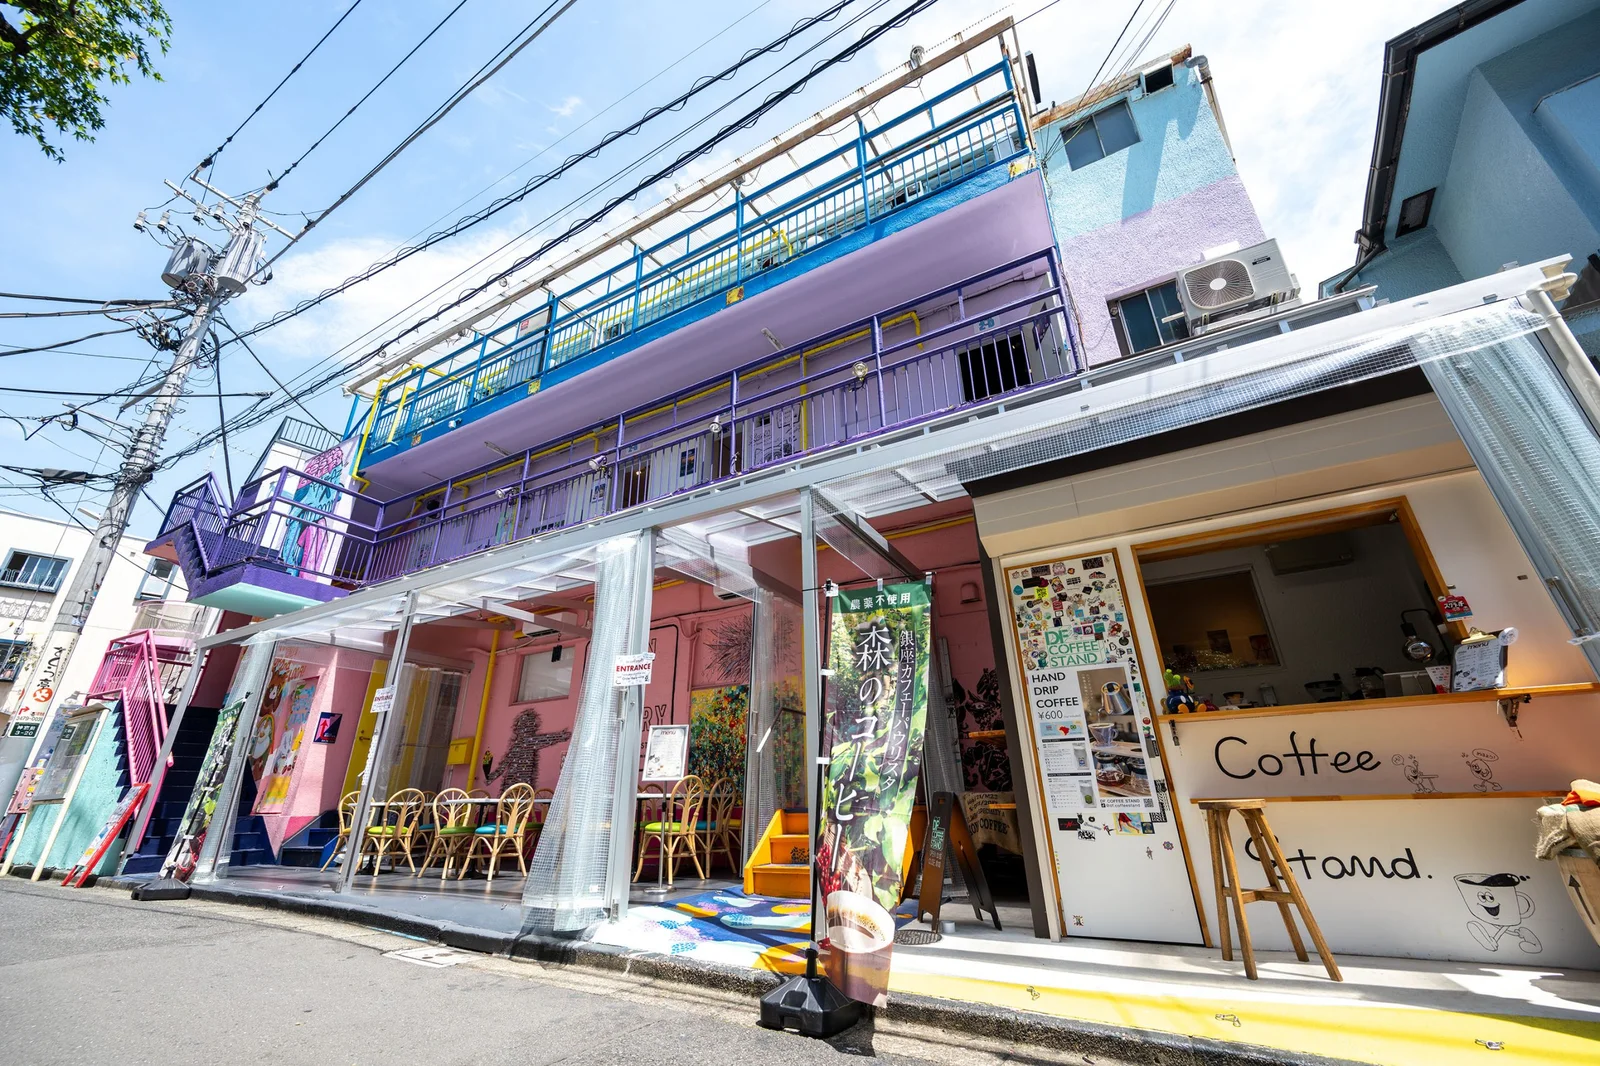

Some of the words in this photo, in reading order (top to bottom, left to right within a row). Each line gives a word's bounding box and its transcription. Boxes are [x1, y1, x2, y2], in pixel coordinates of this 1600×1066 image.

[850, 592, 911, 610] 農薬不使用
[1044, 628, 1069, 645] DF
[1048, 640, 1099, 656] COFFEE
[1467, 642, 1489, 650] menu
[1050, 653, 1098, 667] STAND
[616, 663, 651, 672] ENTRANCE
[1031, 672, 1066, 684] HAND
[1033, 685, 1059, 696] DRIP
[1036, 697, 1079, 709] COFFEE
[880, 630, 915, 792] 銀座カフェーパウリスタ
[1037, 710, 1063, 720] ¥600
[829, 625, 892, 873] 森のコーヒー
[1214, 730, 1381, 780] Coffee
